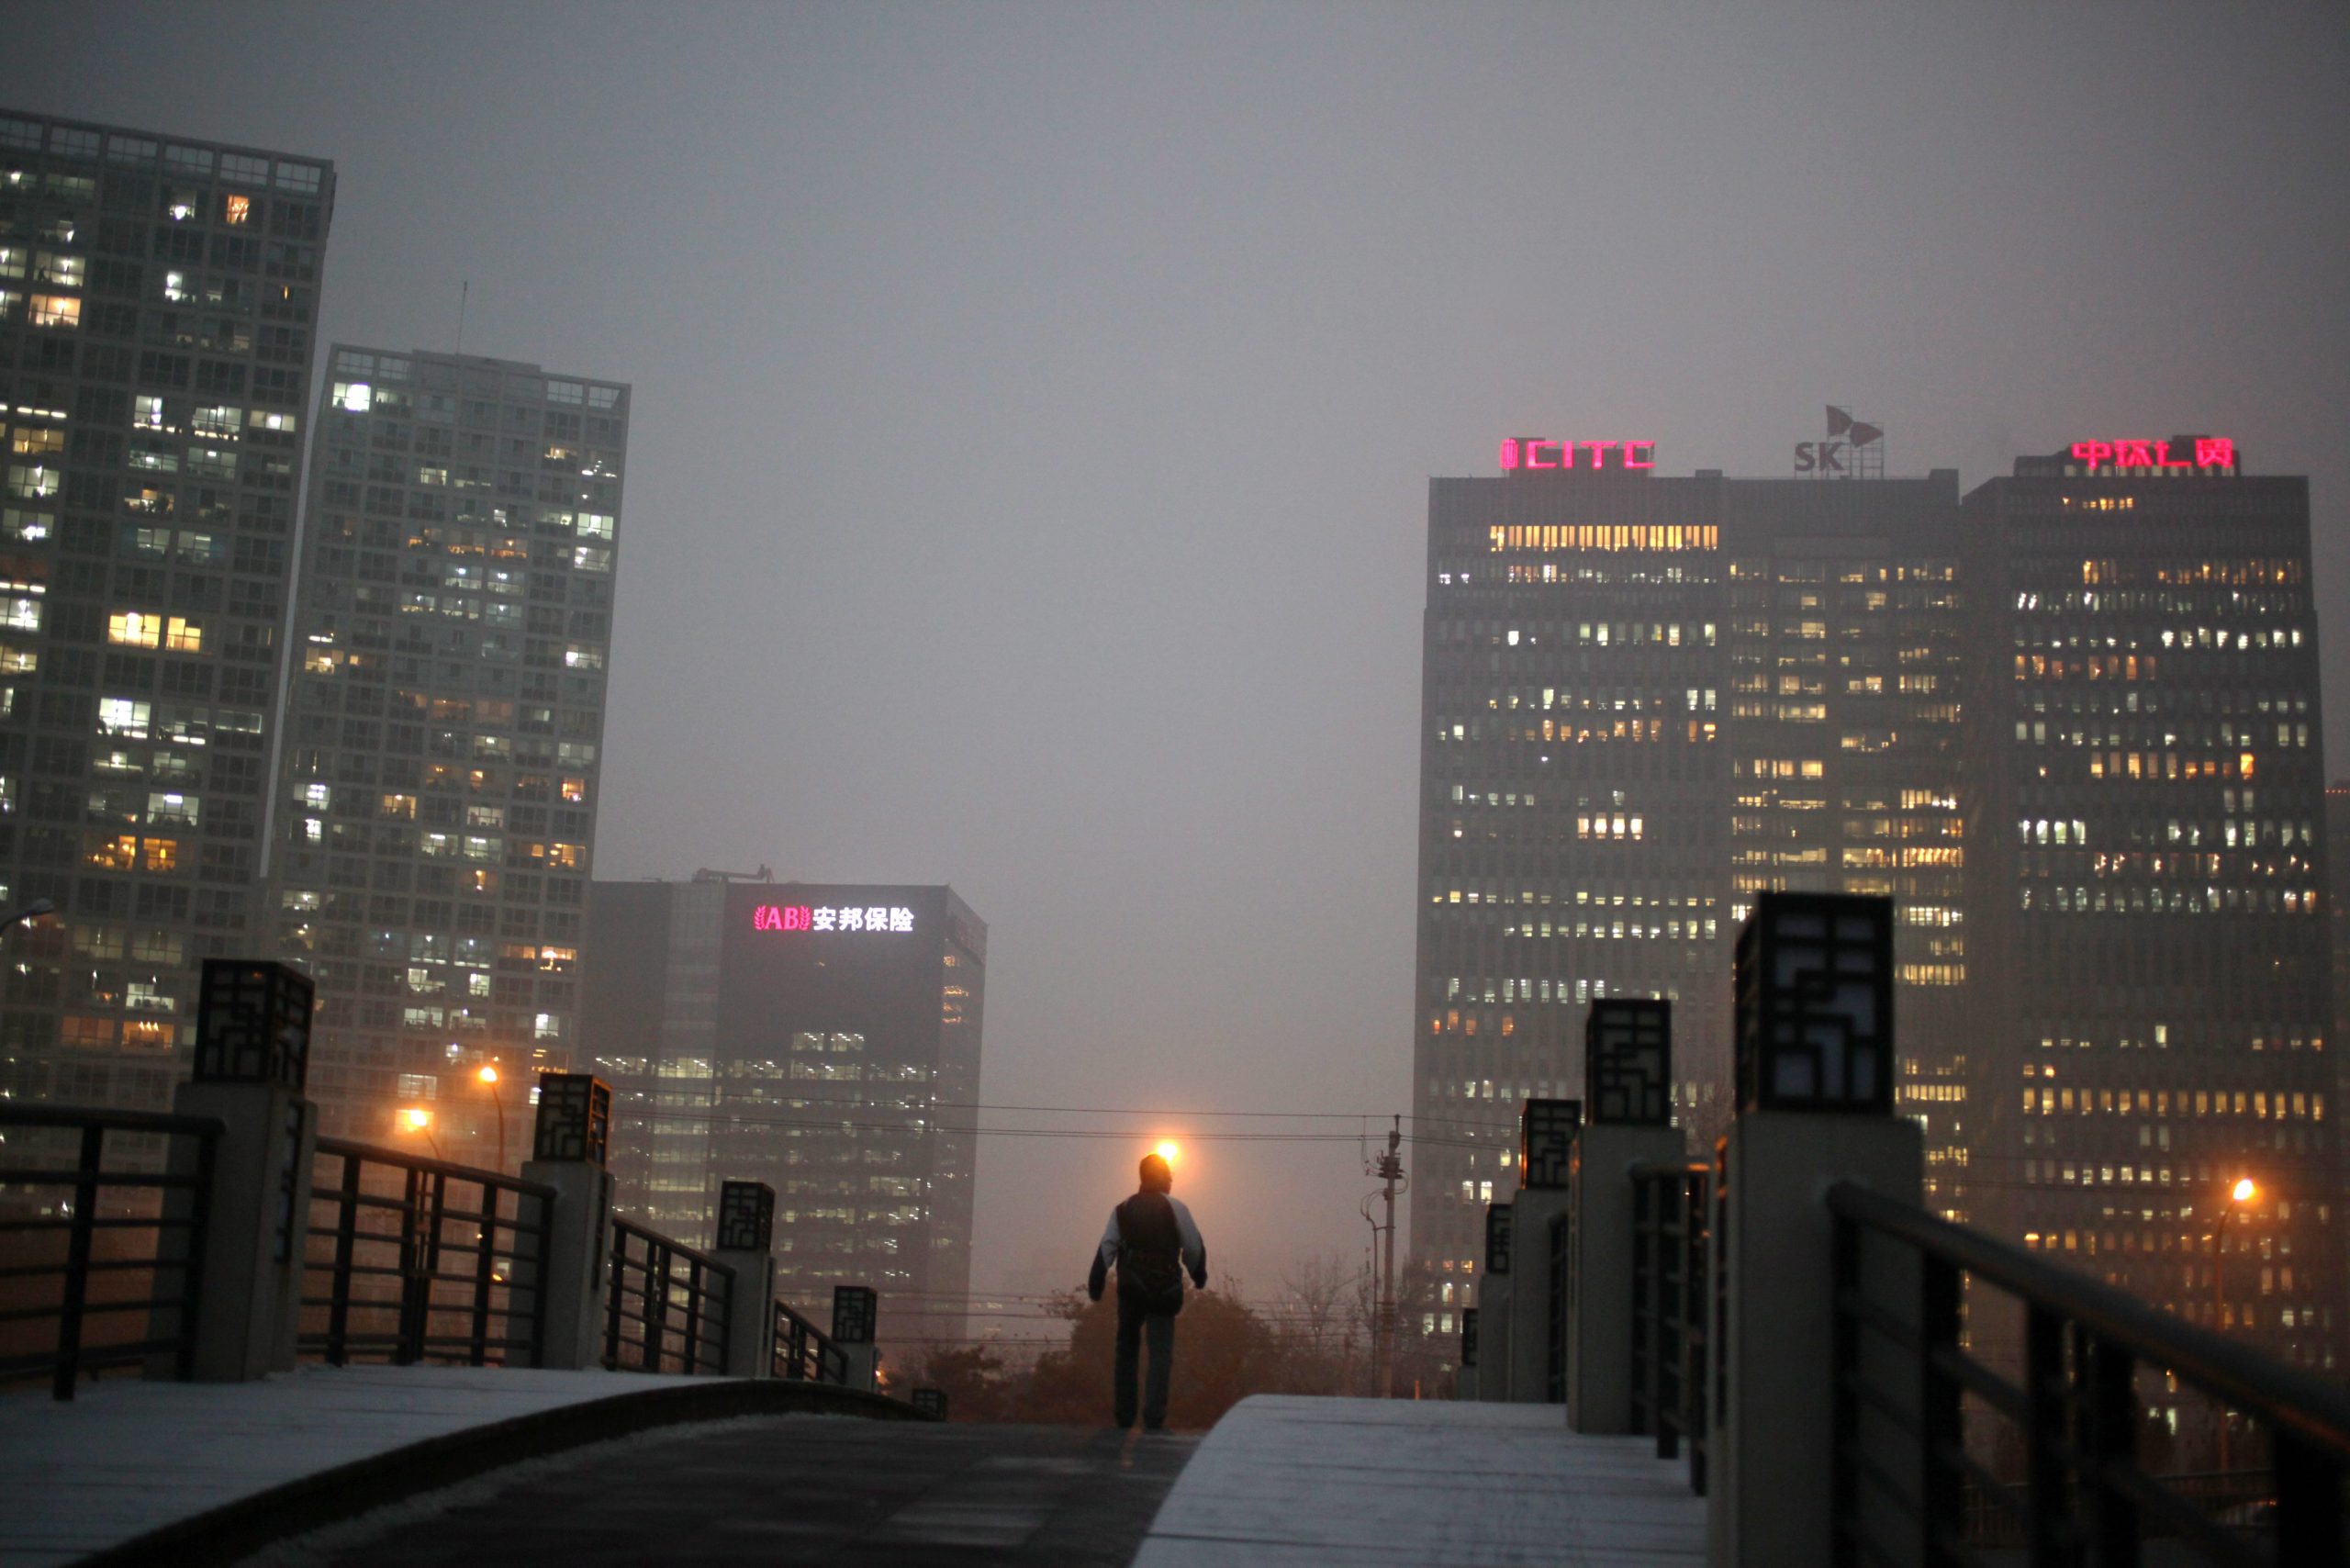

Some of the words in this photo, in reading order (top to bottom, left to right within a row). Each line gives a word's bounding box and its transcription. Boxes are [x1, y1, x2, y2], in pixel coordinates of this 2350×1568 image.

[1794, 442, 1844, 471] SK
[812, 906, 914, 931] 安邦保险
